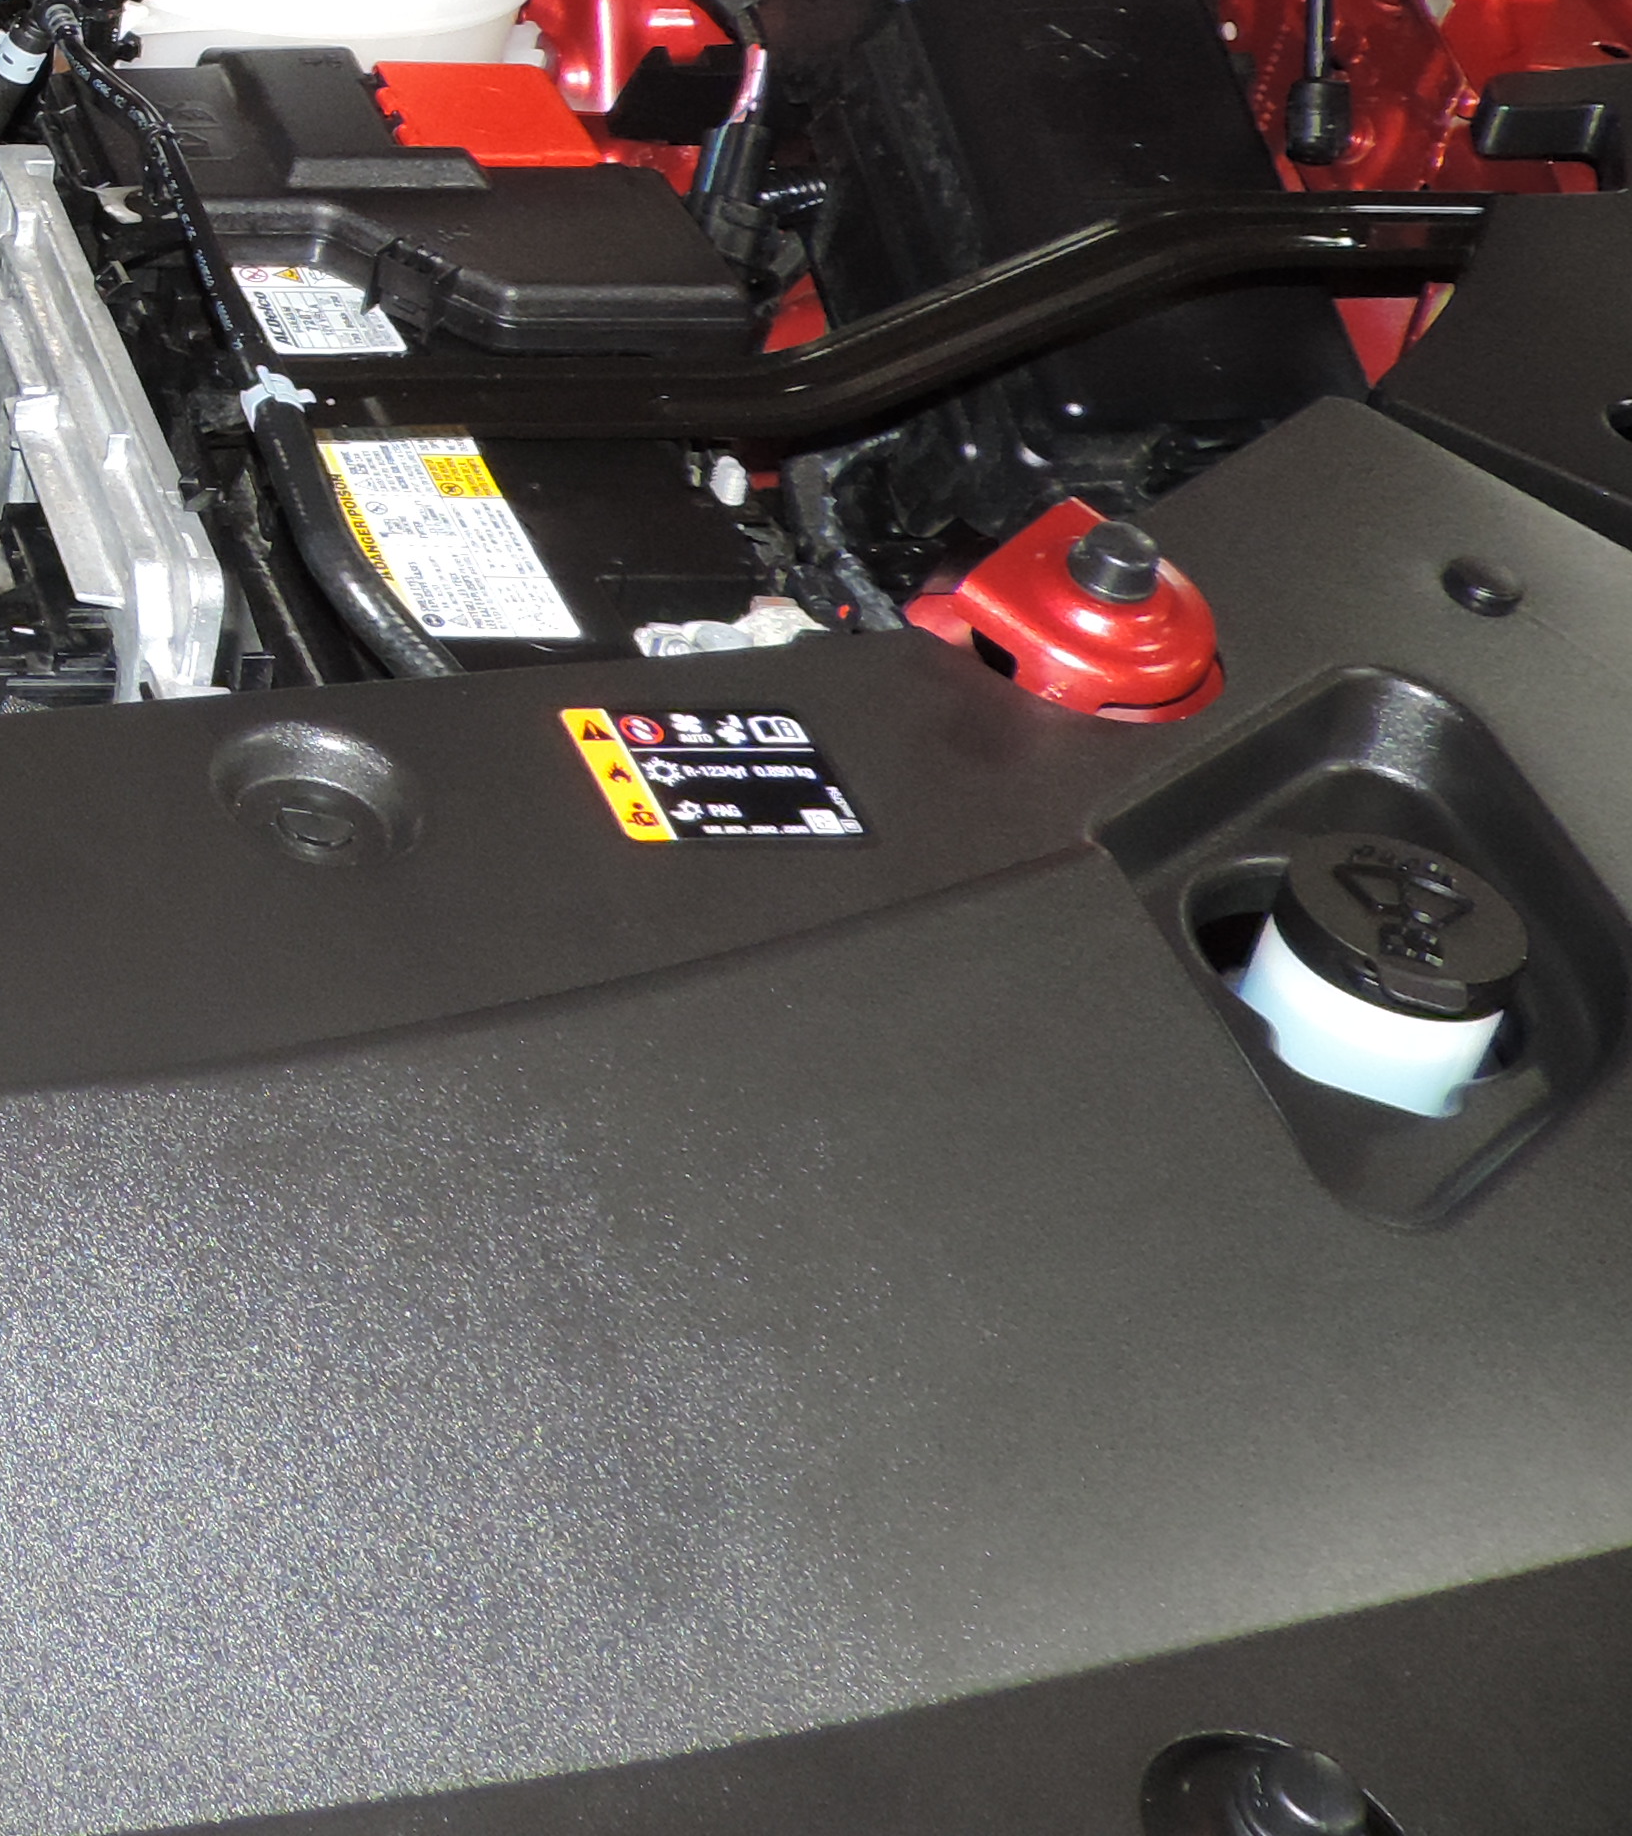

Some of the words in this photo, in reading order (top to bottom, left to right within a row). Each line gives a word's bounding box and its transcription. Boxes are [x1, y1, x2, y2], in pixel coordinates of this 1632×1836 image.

[252, 291, 293, 347] ACDelco
[328, 472, 387, 571] DANGER/POISON
[678, 733, 714, 744] AUTO
[683, 764, 749, 779] R-1234yf
[793, 764, 817, 780] kg
[706, 802, 743, 819] PAG
